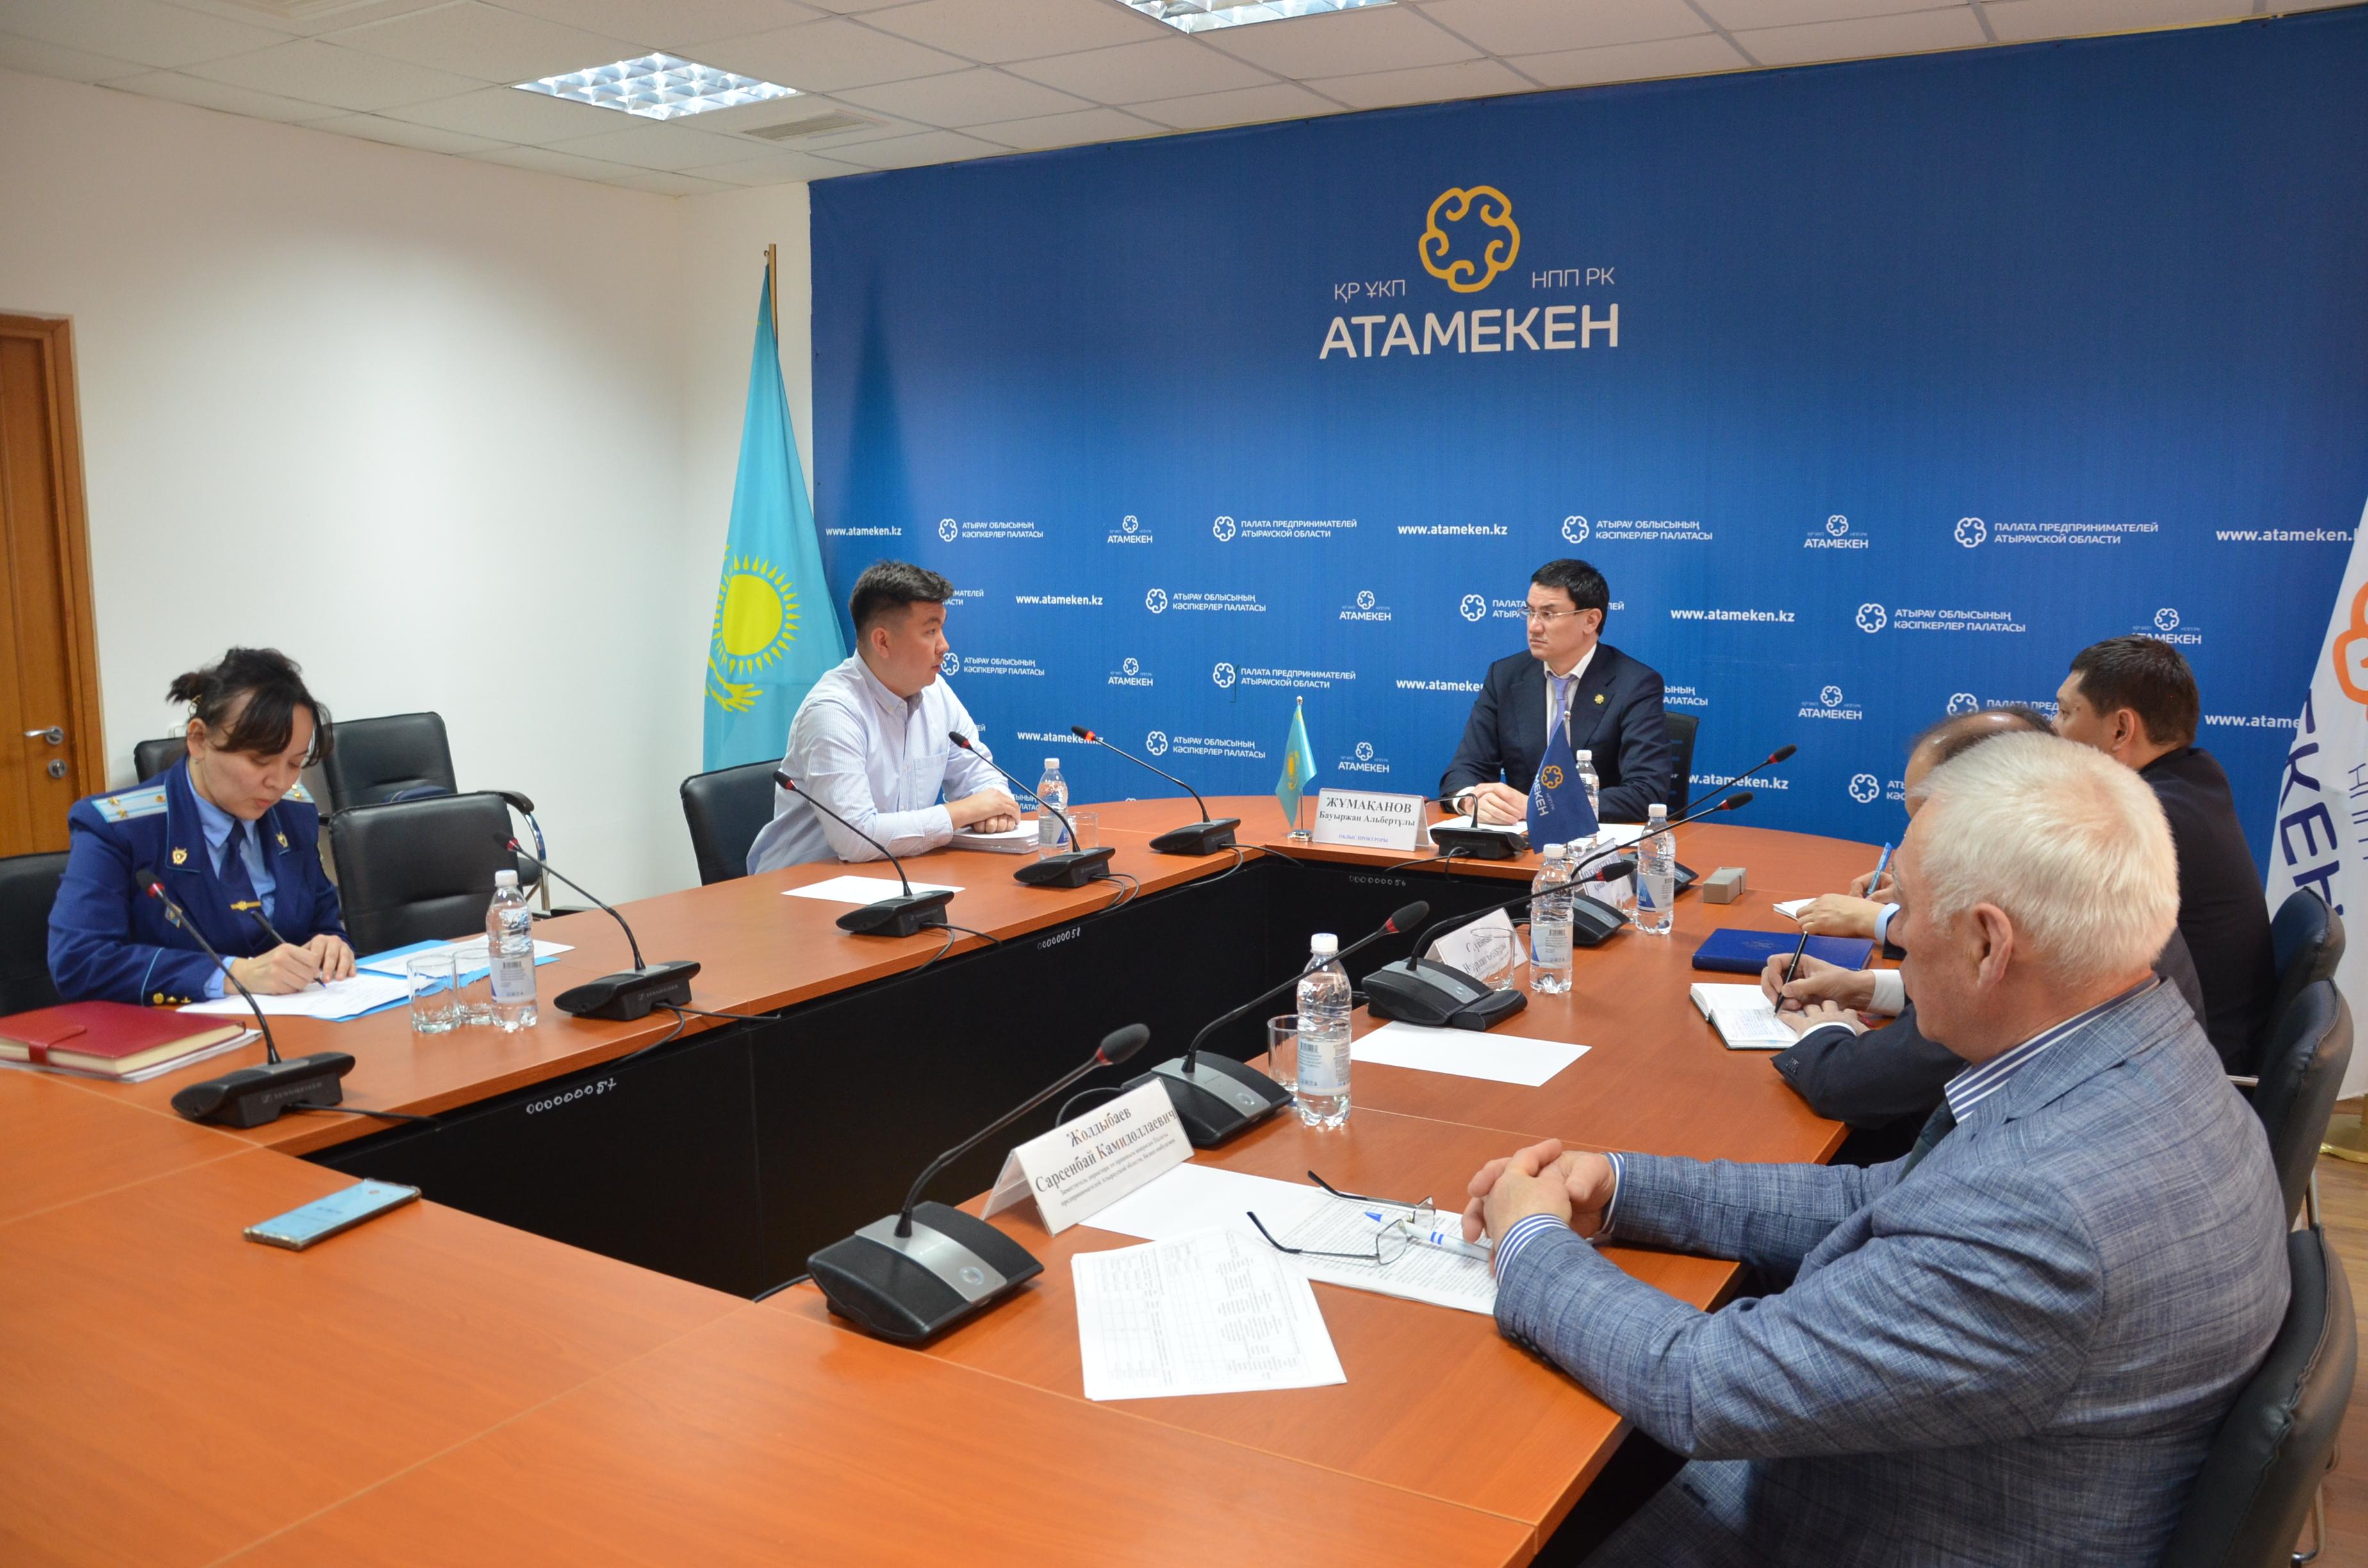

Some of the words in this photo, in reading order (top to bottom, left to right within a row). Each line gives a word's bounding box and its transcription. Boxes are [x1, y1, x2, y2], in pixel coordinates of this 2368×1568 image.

[1533, 269, 1579, 288] НПП
[1586, 267, 1614, 286] РК
[1335, 282, 1360, 303] ҚР
[1319, 304, 1618, 359] АТАМЕКЕН
[1273, 519, 1357, 528] ПРЕДПРИНИМАТЕЛЕЙ
[1635, 521, 1700, 530] ОБЛЫСЫНЫҢ
[2039, 523, 2158, 533] ПРЕДПРИНИМАТЕЛЕЙ
[826, 526, 901, 535] www.atameken.kz
[1242, 529, 1292, 537] АТЫРАУСКОЙ
[1398, 524, 1507, 535] www.atameken.kz
[2216, 528, 2358, 541] www.atameken.
[1661, 532, 1712, 540] ПАЛАТАСЫ
[1994, 534, 2066, 543] АТЫРАУСКОЙ
[2068, 535, 2121, 544] ОБЛАСТИ
[1804, 539, 1868, 548] АТАМЕКЕН
[1016, 595, 1103, 605] www.atameken.kz
[1204, 594, 1256, 603] ОБЛЫСЫНЫҢ
[1340, 612, 1391, 621] АТАМЕКЕН
[1671, 609, 1795, 622] www.atameken.kz
[1895, 609, 1936, 617] АТЫРАУ
[1939, 610, 2011, 621] ОБЛЫСЫНЫҢ
[1894, 621, 1965, 630] КӘСІПКЕРЛЕР
[1967, 623, 2025, 632] ПАЛАТАСЫ
[991, 658, 1035, 667] ОБЛЫСЫНЫҢ
[1272, 669, 1356, 680] ПРЕДПРИНИМАТЕЛЕЙ
[1108, 676, 1153, 686] АТАМЕКЕН
[1241, 676, 1292, 686] АТЫРАУСКОЙ
[1663, 697, 1708, 705] АЛАТАСЫ
[1798, 708, 1862, 719] АТАМЕКЕН
[2205, 715, 2300, 728] www.atame
[1204, 739, 1255, 749] ОБЛЫСЫНЫҢ
[1173, 746, 1222, 755] КӘСІПКЕРЛЕР
[1224, 749, 1265, 758] ПАЛАТАСЫ
[1338, 762, 1389, 772] АТАМЕКЕН
[1326, 797, 1412, 813] ЖҰМАҚАНОВ
[1319, 811, 1361, 822] Бауыржан
[1363, 815, 1415, 827] Альбертұлы
[1066, 1107, 1131, 1148] Жолдыбаев
[1035, 1149, 1097, 1193] Сарсенбай
[1096, 1109, 1177, 1160] Камидоллаевич
